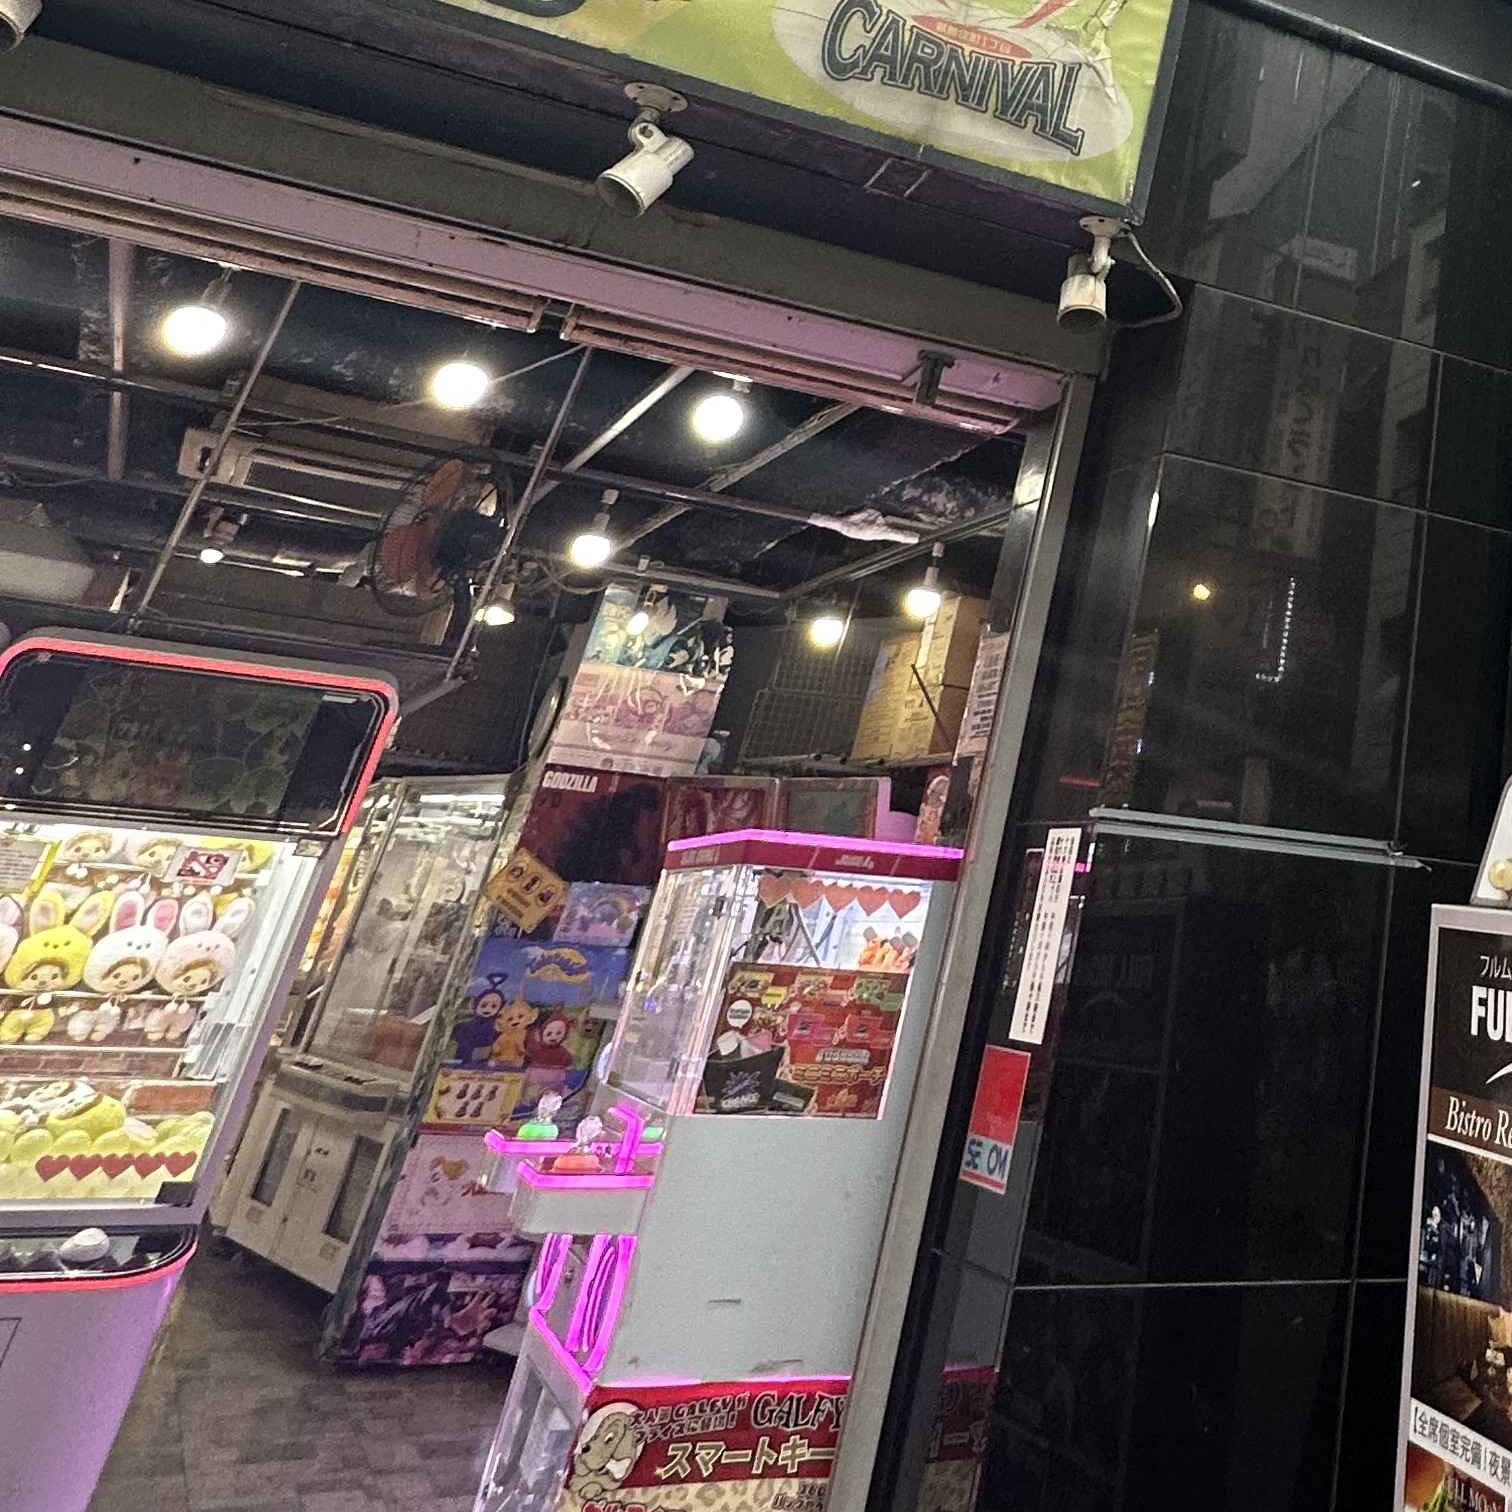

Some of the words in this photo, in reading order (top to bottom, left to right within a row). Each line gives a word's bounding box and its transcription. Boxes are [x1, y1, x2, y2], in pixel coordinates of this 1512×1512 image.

[542, 770, 599, 793] GODZILLA
[1445, 1095, 1493, 1142] Bistro
[752, 1390, 849, 1432] GALFY
[658, 1435, 837, 1481] スマートキー
